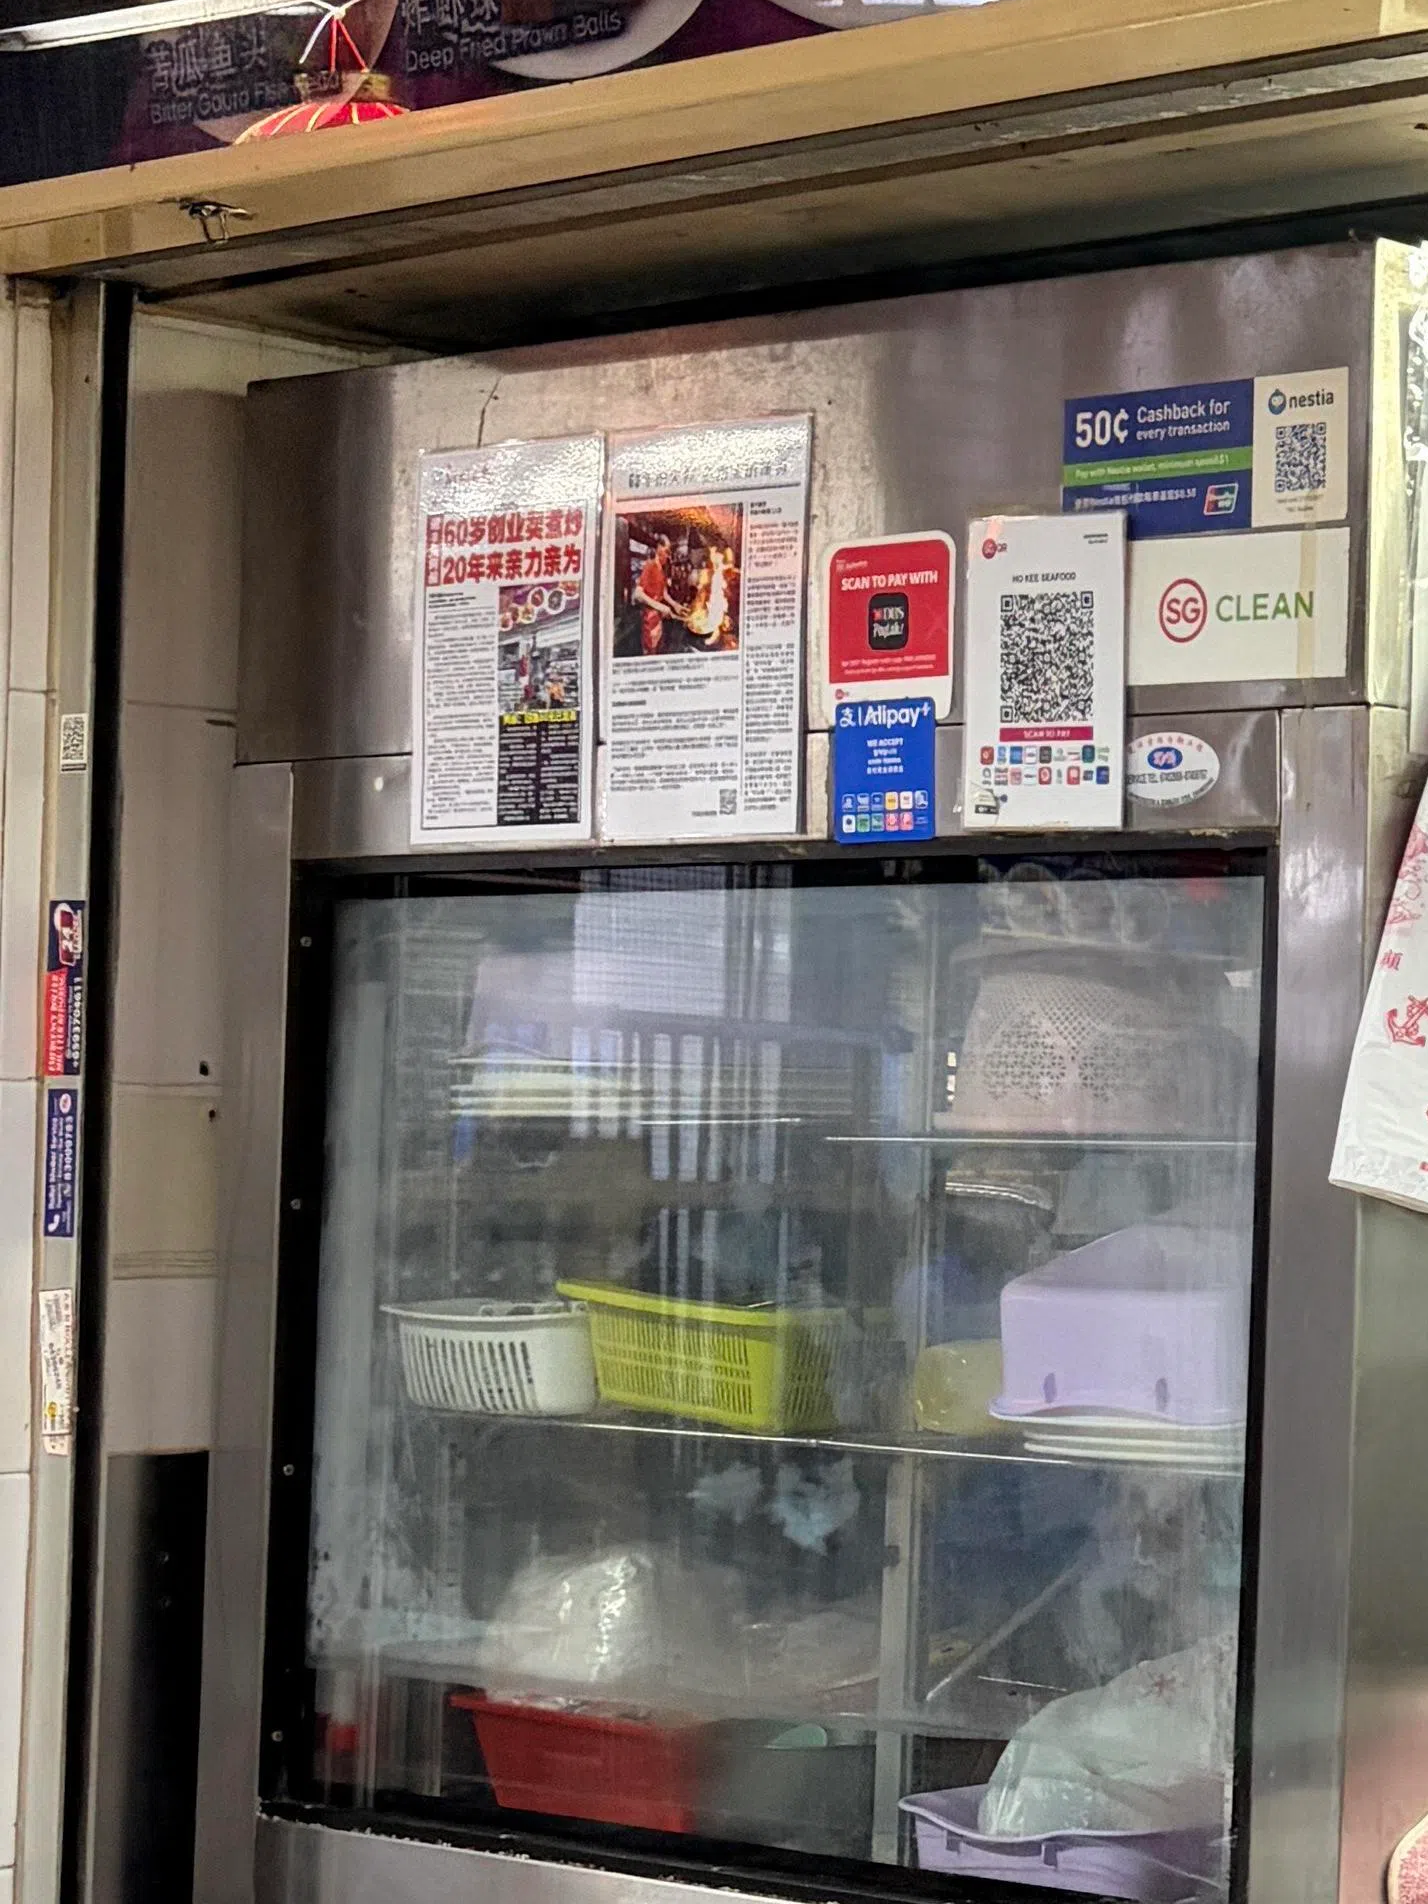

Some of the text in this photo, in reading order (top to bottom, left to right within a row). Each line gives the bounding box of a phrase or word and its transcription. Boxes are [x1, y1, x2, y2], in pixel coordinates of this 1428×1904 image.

[406, 46, 454, 73] Deep
[509, 23, 569, 49] Prawn
[573, 9, 622, 37] Balls
[1136, 399, 1231, 424] Cashback for
[1289, 389, 1335, 409] nestia
[1074, 407, 1130, 448] 50¢
[1136, 420, 1231, 442] every transaction
[841, 570, 938, 591] SCAN TO PAY WITH
[1165, 590, 1315, 625] SG CLEAN
